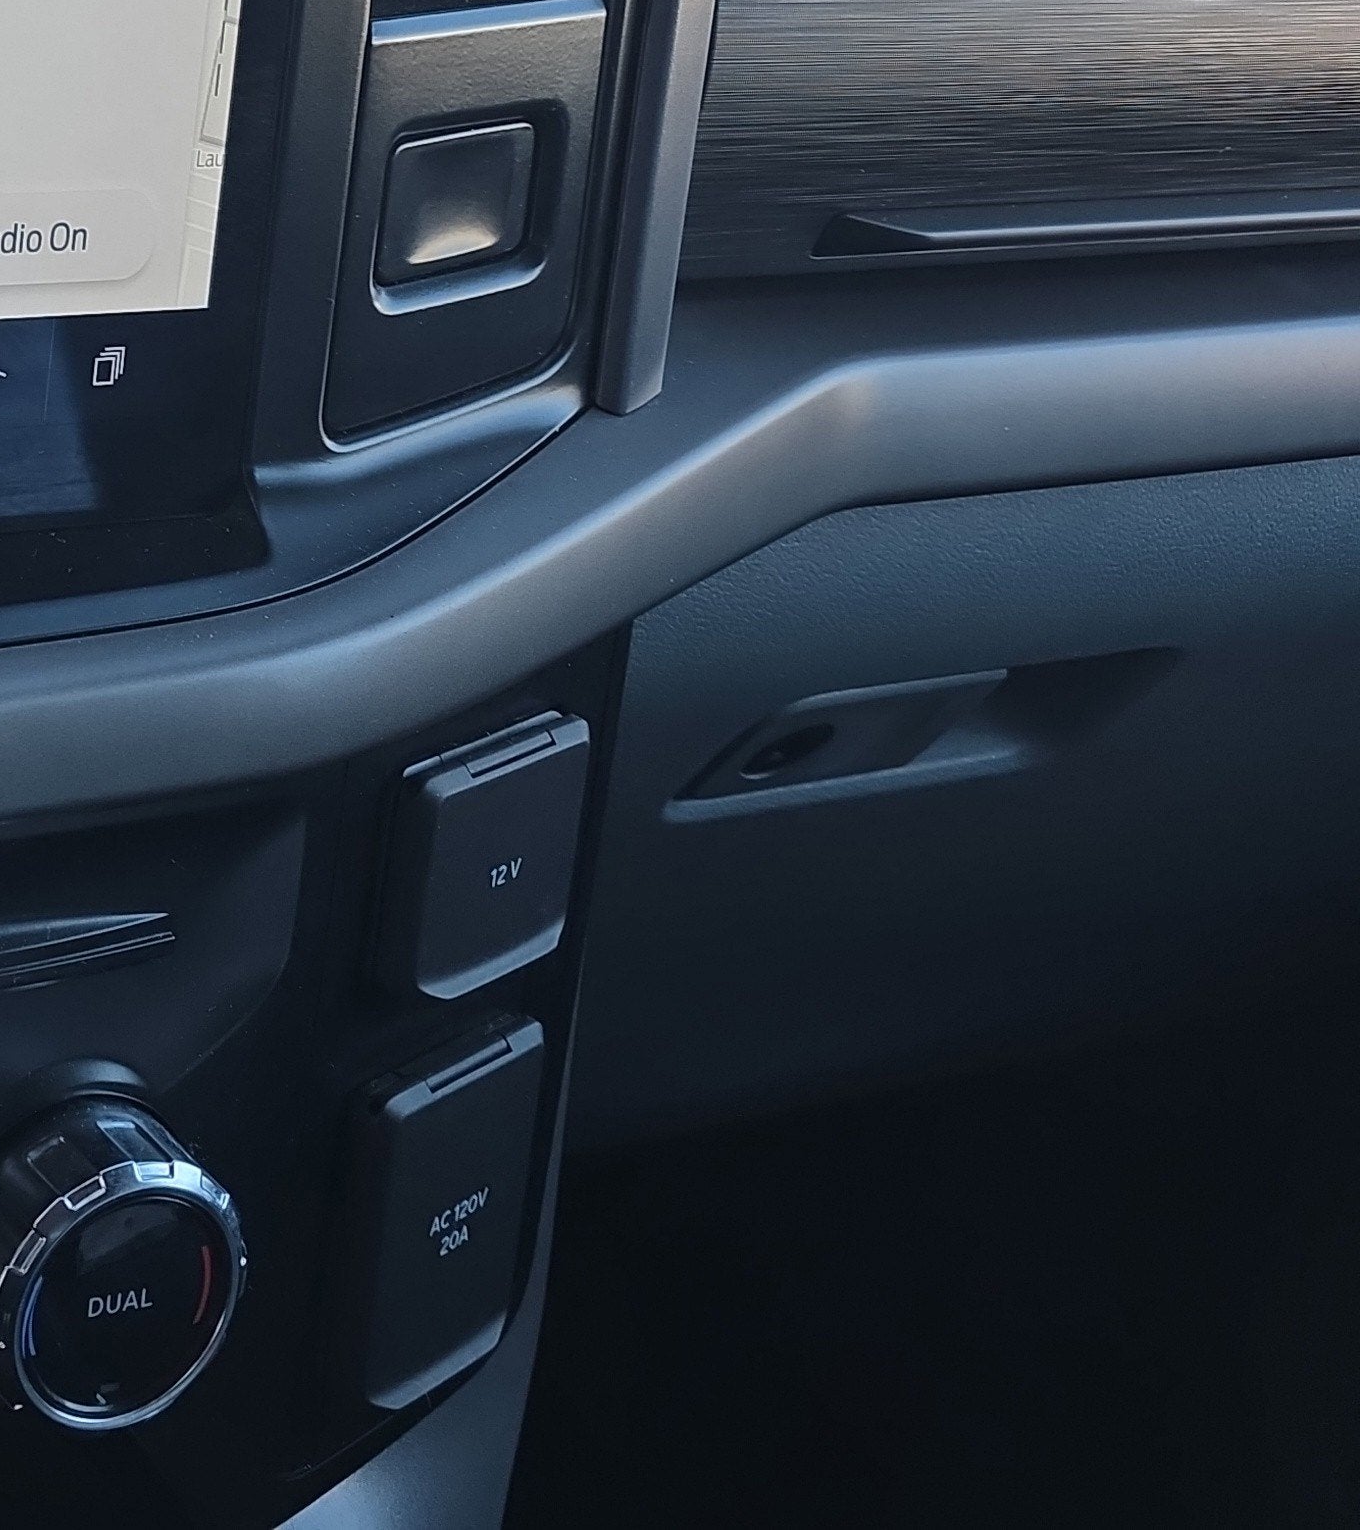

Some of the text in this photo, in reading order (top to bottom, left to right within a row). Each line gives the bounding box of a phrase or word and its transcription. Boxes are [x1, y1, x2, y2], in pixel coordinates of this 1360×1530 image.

[49, 222, 87, 252] On
[440, 1224, 469, 1257] 20A
[87, 1287, 153, 1318] DUAL
